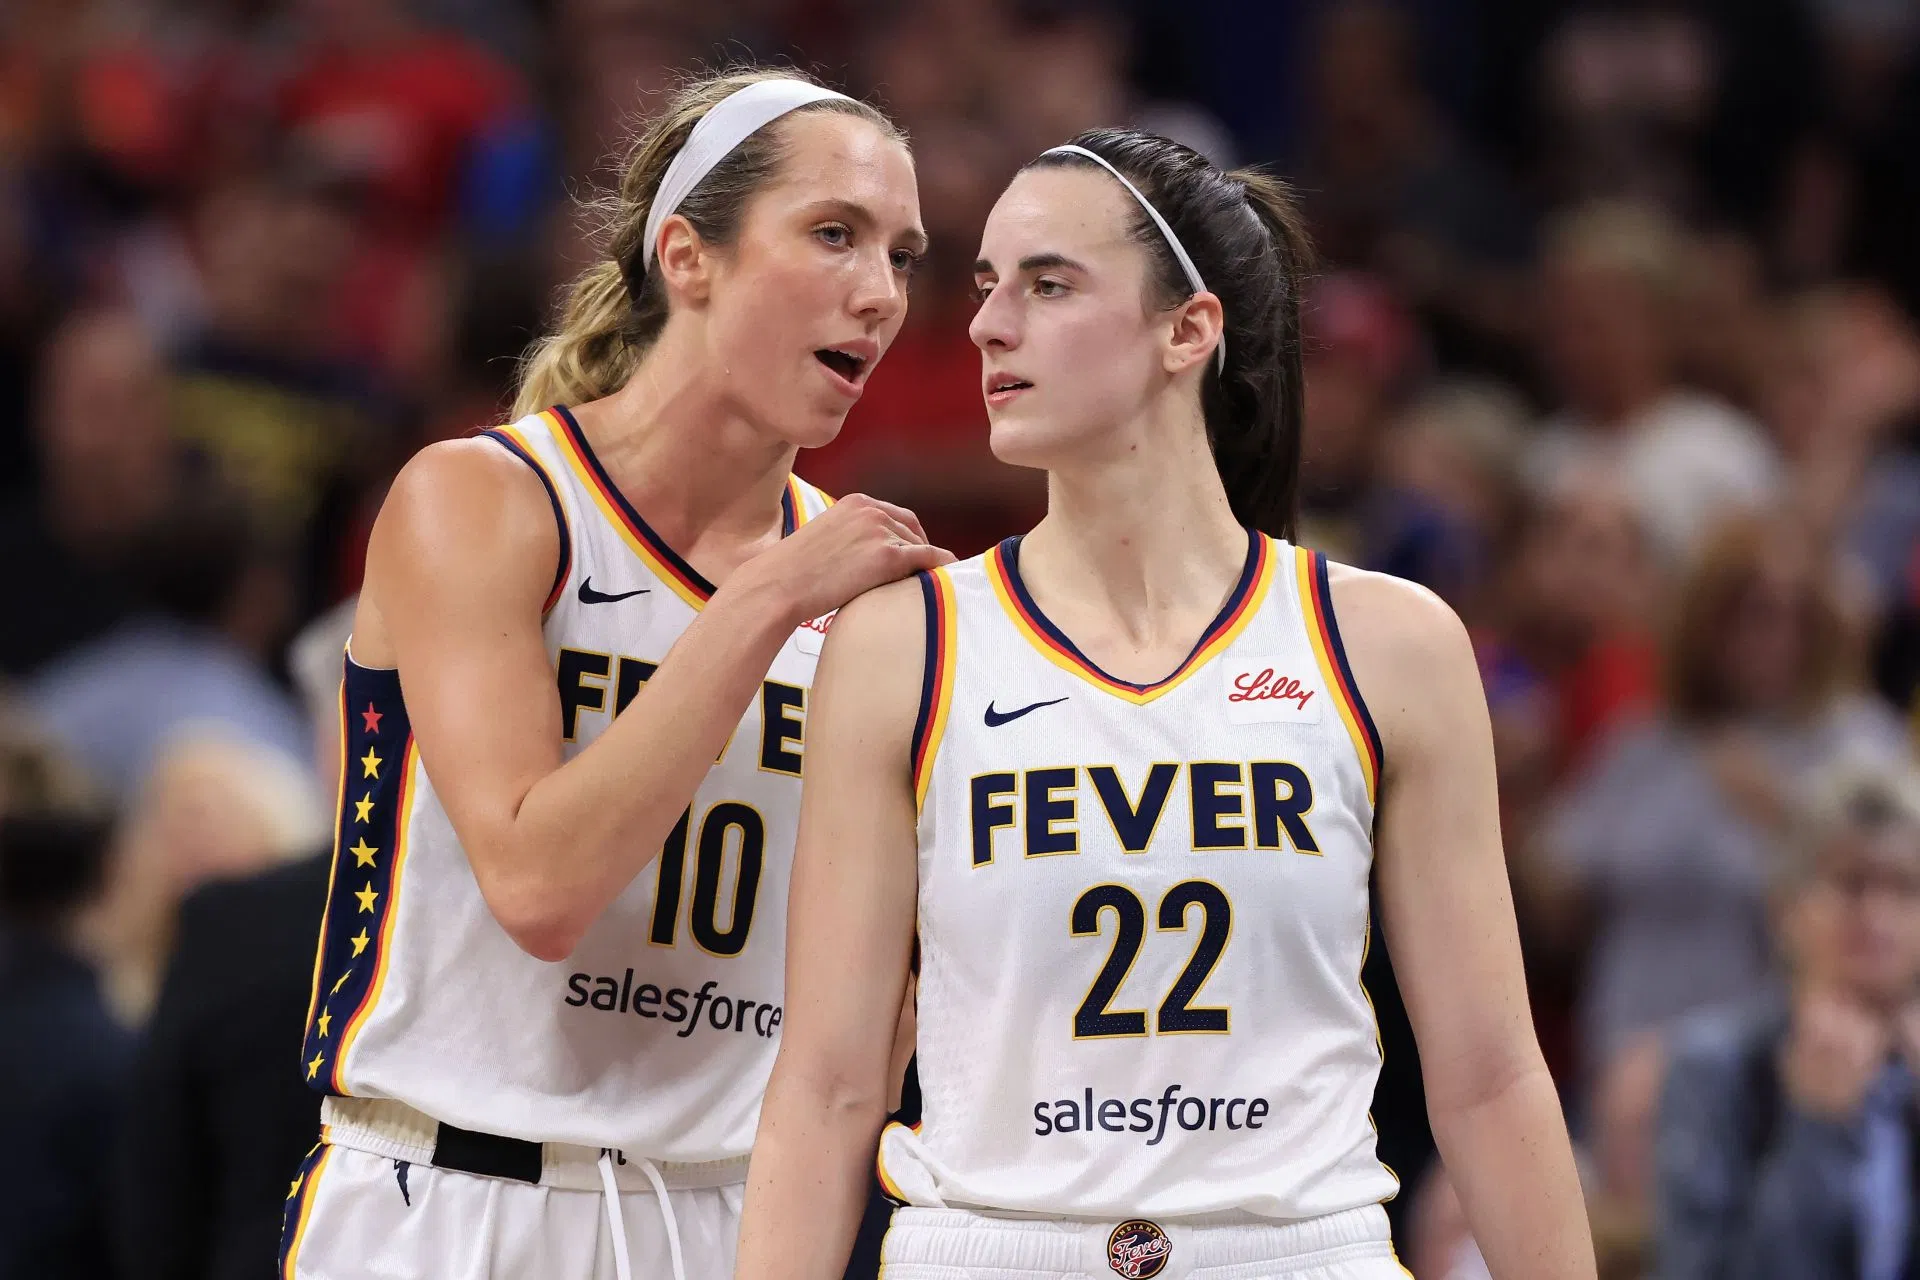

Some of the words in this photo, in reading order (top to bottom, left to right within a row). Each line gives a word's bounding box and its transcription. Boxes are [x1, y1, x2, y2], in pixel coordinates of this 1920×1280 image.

[556, 646, 809, 779] FEE
[1229, 668, 1314, 710] Lilly
[970, 760, 1324, 869] FEVER
[647, 800, 768, 959] 10
[1069, 877, 1234, 1041] 22
[564, 967, 783, 1039] salesforce
[1034, 1084, 1269, 1146] salesforce
[1110, 1234, 1172, 1270] Fever
[1115, 1224, 1158, 1240] INDIANA
